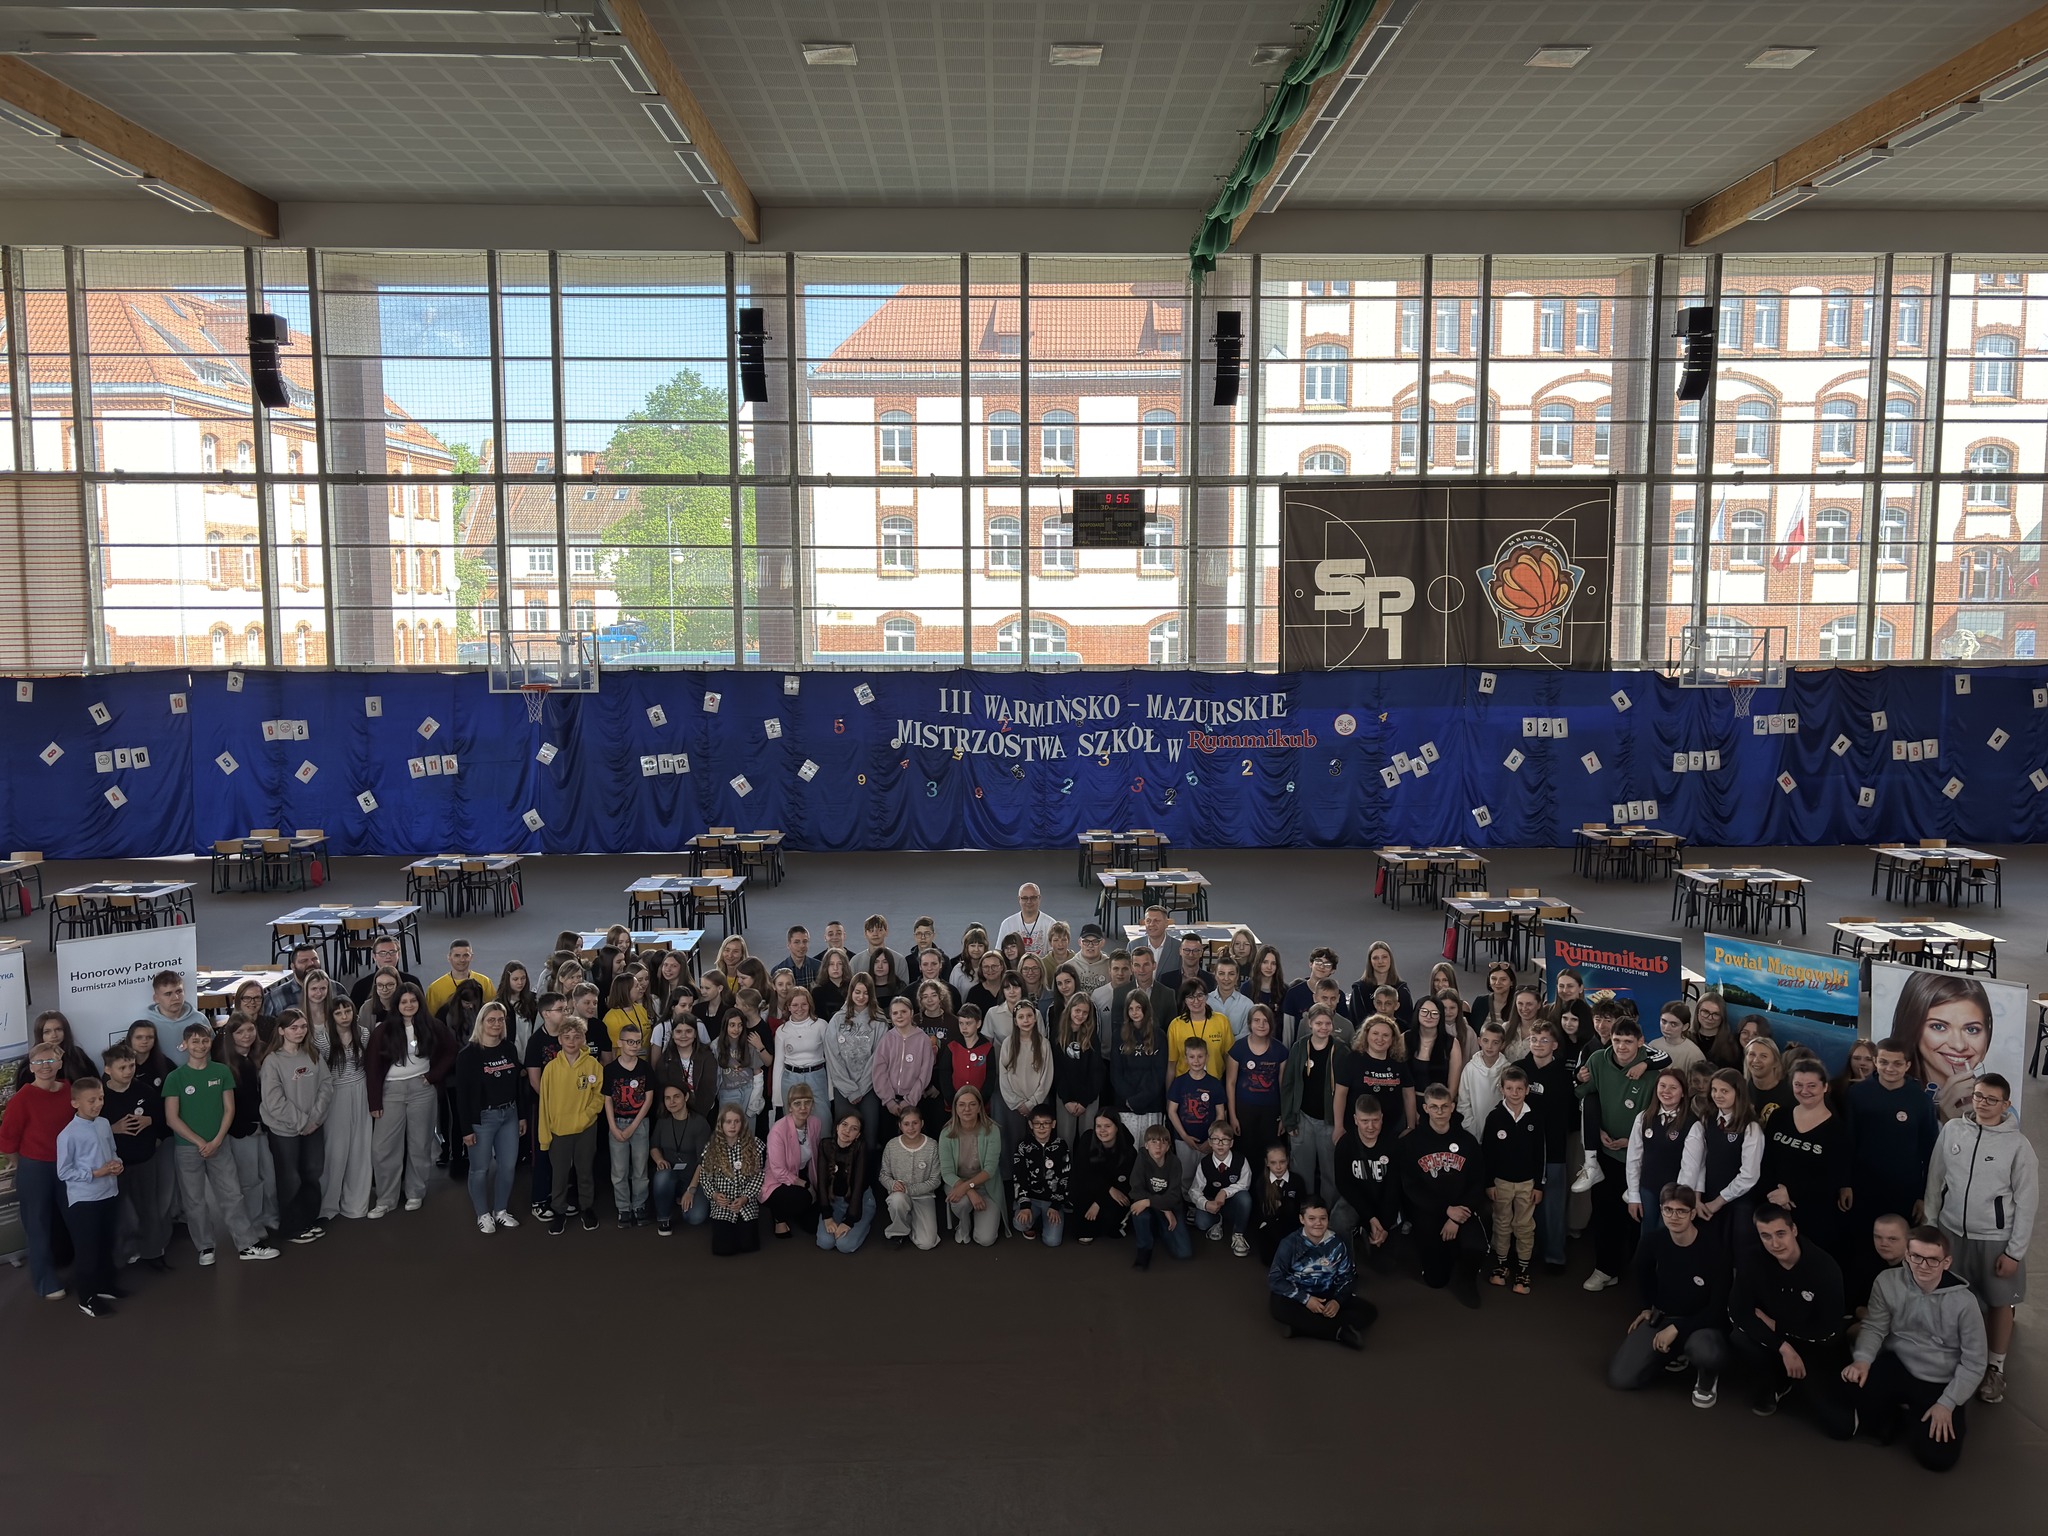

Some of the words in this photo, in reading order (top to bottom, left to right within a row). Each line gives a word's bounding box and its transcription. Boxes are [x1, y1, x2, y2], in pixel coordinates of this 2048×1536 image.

[1105, 493, 1112, 504] 9
[1116, 493, 1130, 504] 55
[1501, 614, 1561, 646] AS
[232, 677, 238, 687] 3
[1483, 678, 1492, 688] 13
[1960, 679, 1965, 689] 7
[22, 686, 28, 696] 9
[173, 698, 183, 708] 10
[2038, 694, 2043, 703] 9
[371, 702, 377, 711] 6
[938, 688, 972, 715] III
[1146, 692, 1287, 726] MAZURSKIE
[95, 708, 106, 718] 11
[998, 717, 1012, 733] 2
[1757, 720, 1765, 730] 12
[1788, 719, 1796, 729] 12
[1877, 716, 1882, 726] 7
[268, 726, 274, 736] 8
[834, 719, 845, 735] 5
[1528, 722, 1533, 732] 3
[1543, 722, 1548, 732] 2
[1558, 723, 1562, 733] 1
[897, 719, 1067, 762] MISTRZOSTWA
[1187, 729, 1318, 754] Rummikub
[1994, 735, 2003, 744] 4
[1838, 741, 1845, 750] 4
[1897, 745, 1902, 755] 5
[1928, 744, 1934, 753] 7
[120, 754, 126, 763] 9
[135, 753, 146, 763] 10
[223, 758, 231, 767] 5
[1098, 750, 1110, 767] 3
[1588, 758, 1594, 767] 7
[1694, 756, 1699, 766] 6
[1711, 756, 1715, 765] 7
[429, 761, 437, 770] 11
[445, 760, 454, 770] 10
[676, 759, 686, 769] 12
[1242, 760, 1253, 776] 2
[1329, 759, 1342, 777] 3
[1387, 772, 1394, 782] 2
[1399, 758, 1405, 768] 3
[1416, 762, 1422, 772] 4
[1426, 748, 1434, 757] 5
[858, 774, 866, 785] 9
[1186, 771, 1199, 786] 5
[1782, 777, 1792, 787] 10
[2036, 775, 2042, 784] 1
[927, 781, 938, 798] 3
[1061, 778, 1074, 795] 2
[1132, 777, 1145, 793] 3
[1949, 784, 1957, 793] 2
[112, 793, 120, 801] 4
[1165, 788, 1177, 805] 2
[1864, 792, 1870, 802] 8
[1478, 811, 1488, 822] 10
[1618, 810, 1623, 819] 4
[1633, 806, 1638, 815] 5
[1648, 805, 1654, 815] 6
[1554, 939, 1669, 974] Rummikub
[1715, 948, 1762, 971] Powiat
[70, 965, 131, 981] Honorowy
[135, 957, 182, 972] Patronat
[1601, 964, 1620, 973] PEOPLE
[1621, 967, 1648, 977] TOGETHER
[0, 972, 14, 980] YKA
[71, 981, 116, 993] Burmistrza
[118, 977, 146, 986] Miasta
[1773, 1131, 1823, 1155] GUESS
